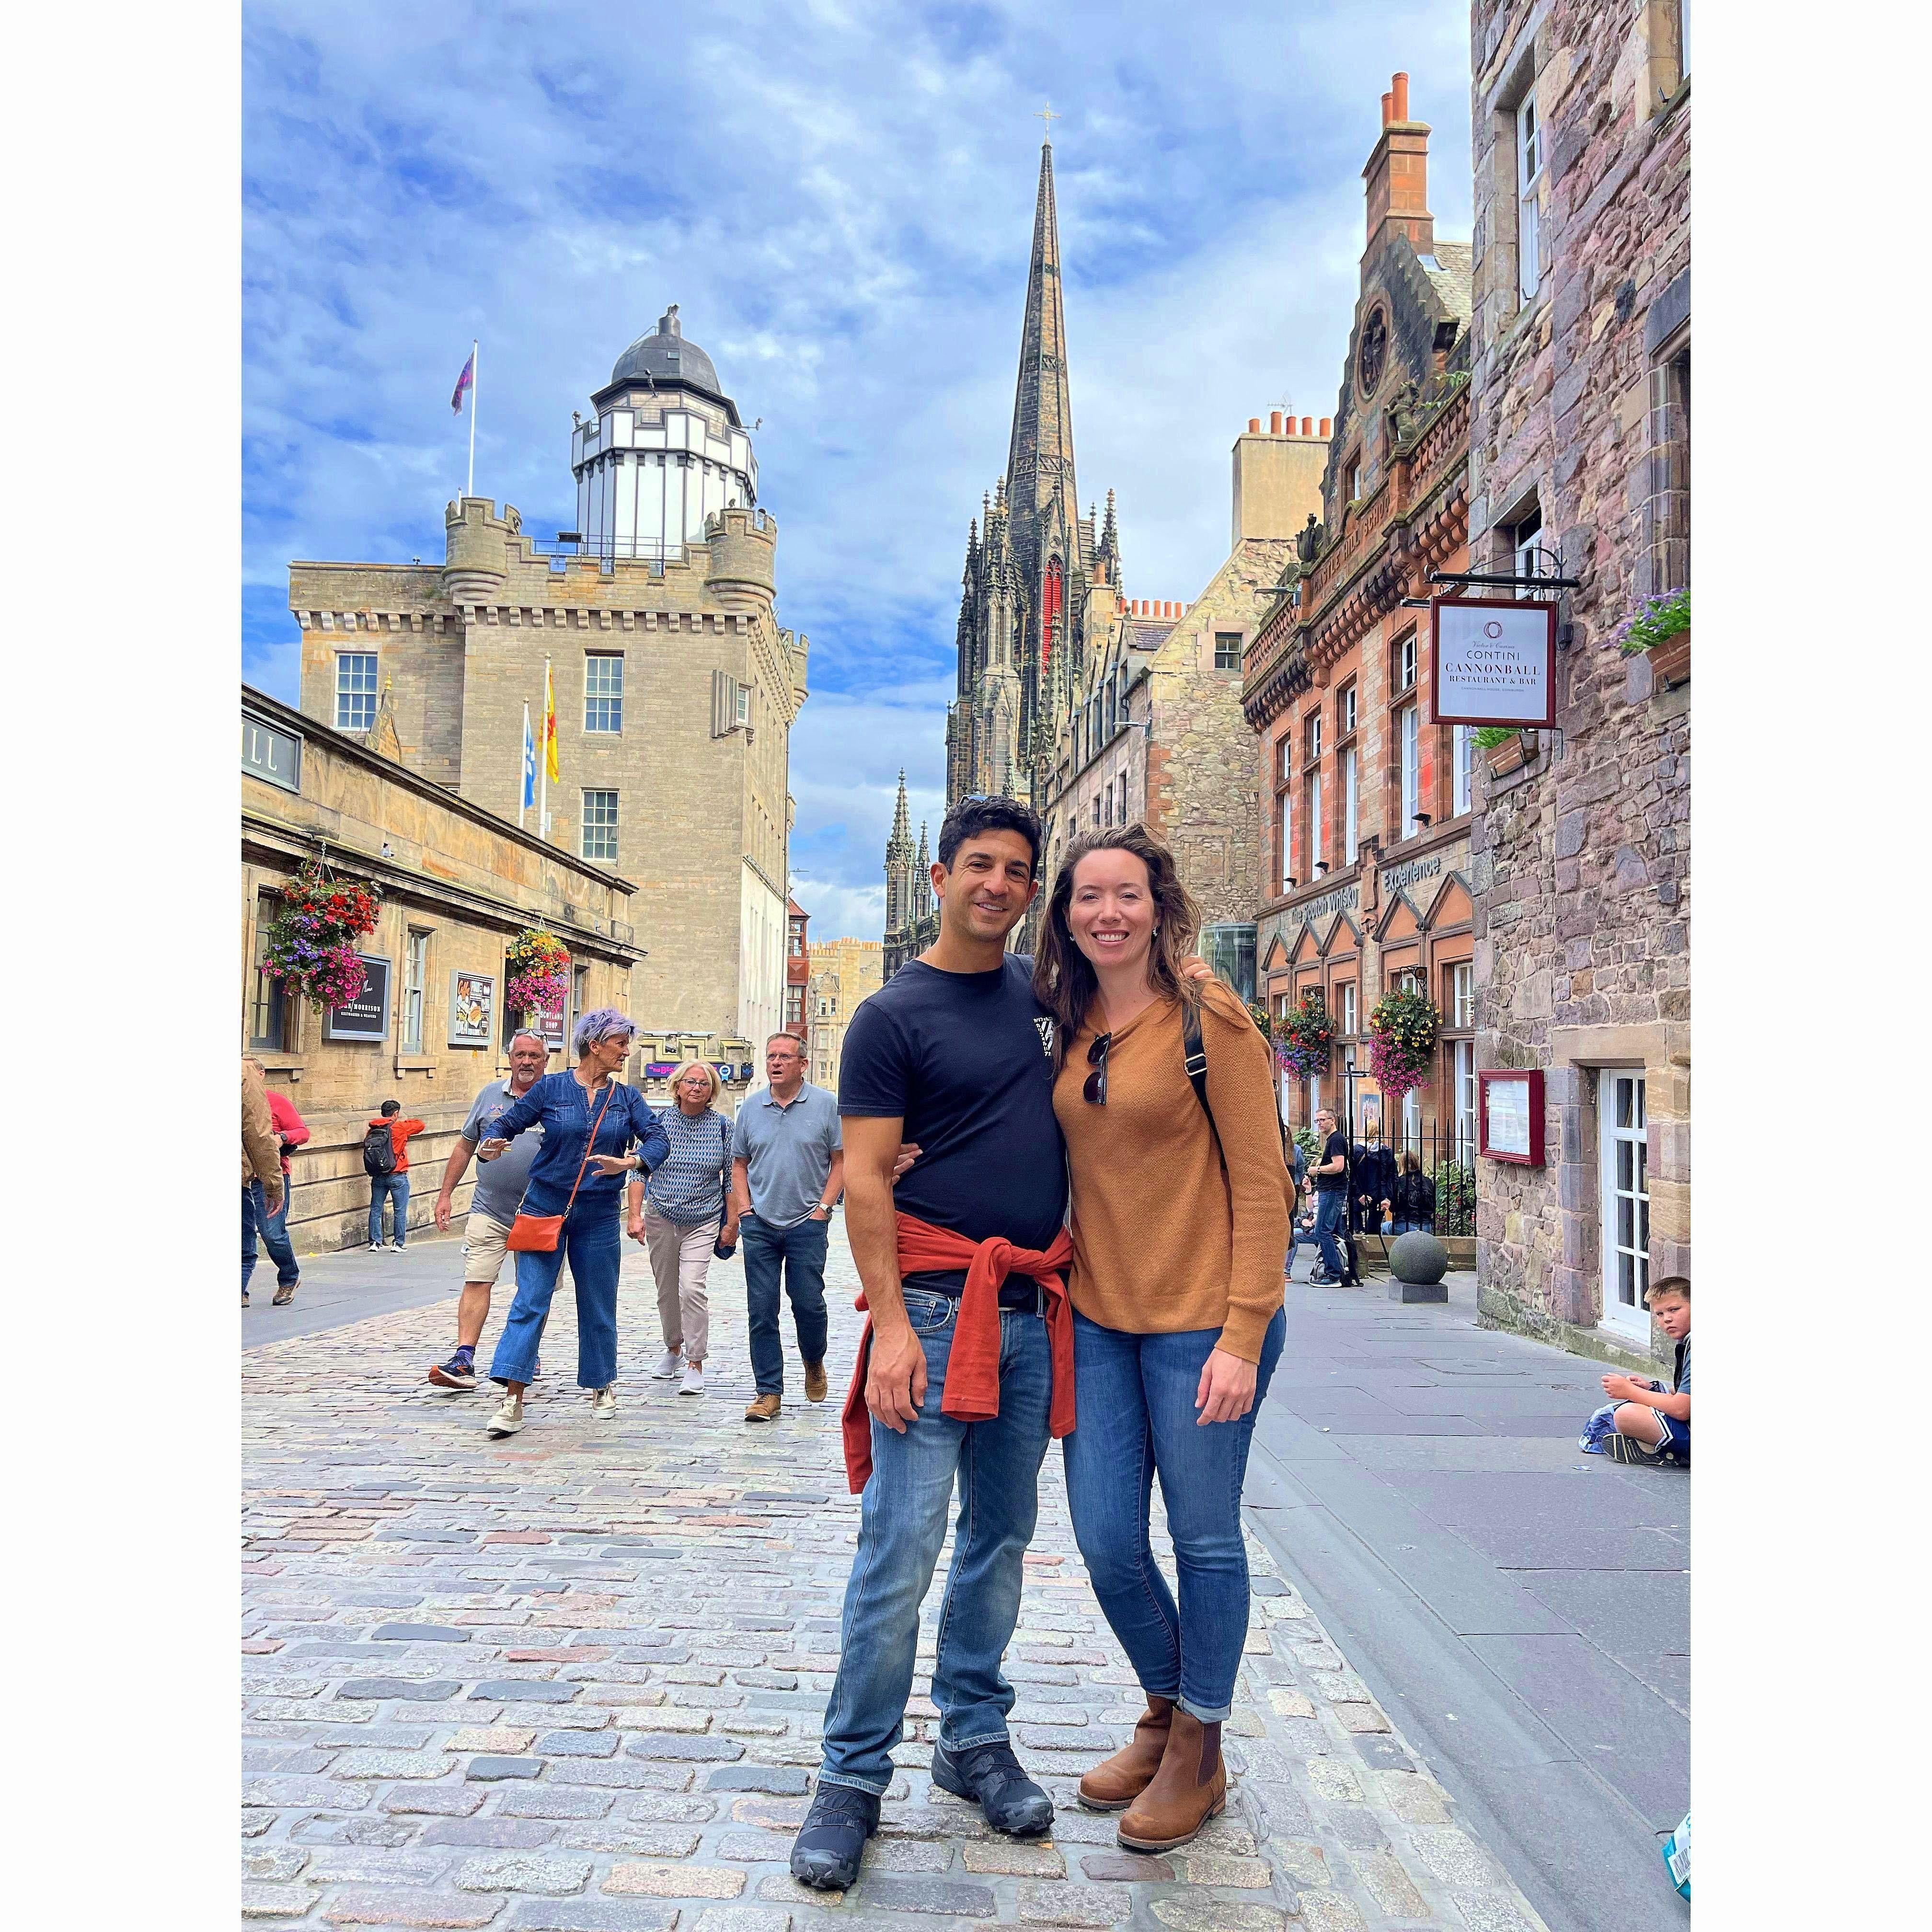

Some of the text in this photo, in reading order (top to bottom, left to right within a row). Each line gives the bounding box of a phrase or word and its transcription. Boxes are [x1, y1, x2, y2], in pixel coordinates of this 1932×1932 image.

[1315, 494, 1389, 593] CASTLE HILL SCHOO
[1467, 650, 1519, 660] CONTINI
[1446, 663, 1541, 675] CANNONBALL
[1449, 675, 1506, 684] RESTAURANT
[242, 723, 277, 771] ILL
[1383, 855, 1441, 892] Experience
[1291, 885, 1358, 925] The Scotch Whisky
[354, 1003, 380, 1012] MORRISON
[540, 1011, 563, 1021] SCOTLAND
[661, 1066, 674, 1074] BES
